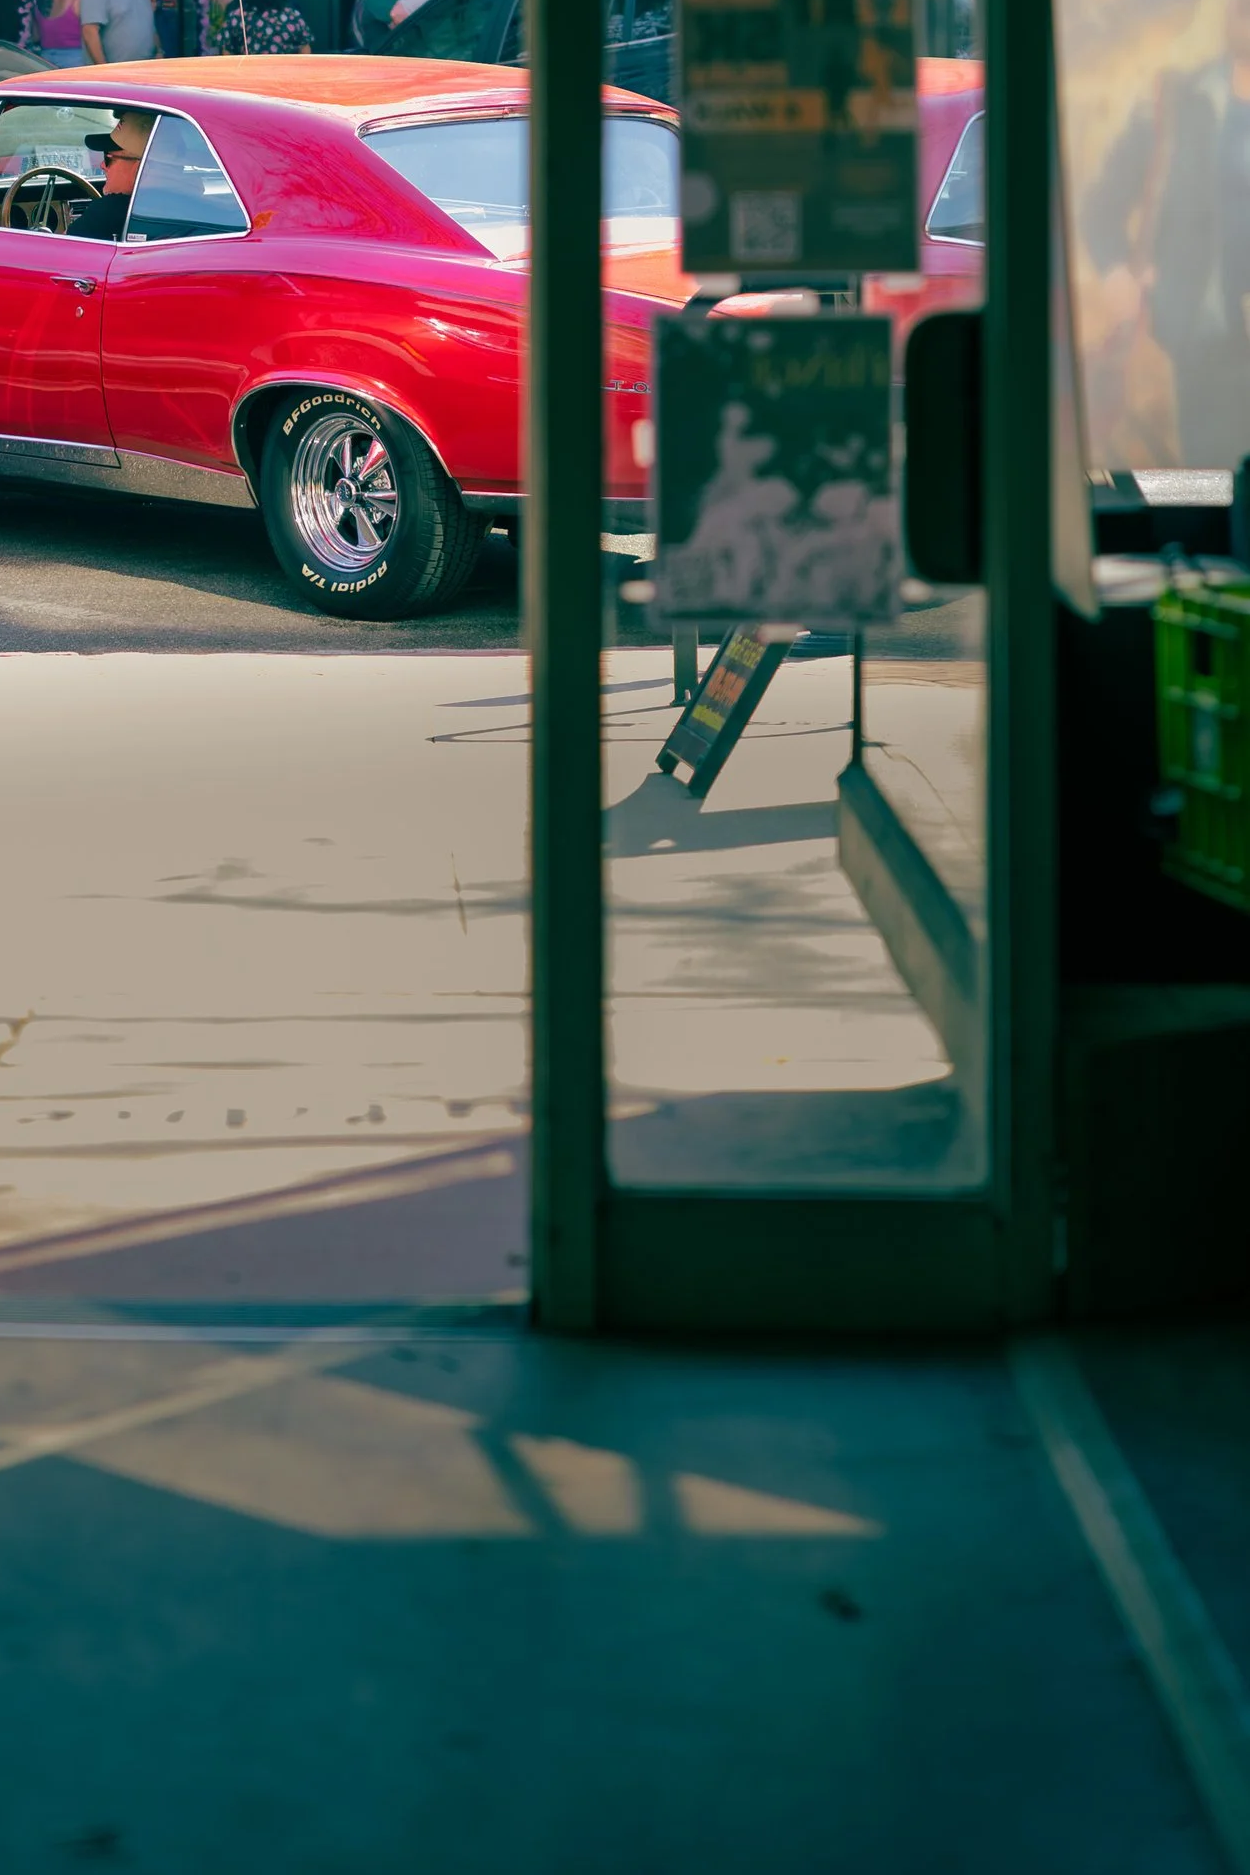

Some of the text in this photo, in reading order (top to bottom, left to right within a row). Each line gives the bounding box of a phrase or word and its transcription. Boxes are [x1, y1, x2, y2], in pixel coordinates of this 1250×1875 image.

[282, 393, 382, 436] BFGoodrich
[301, 561, 388, 593] Radial T/A
